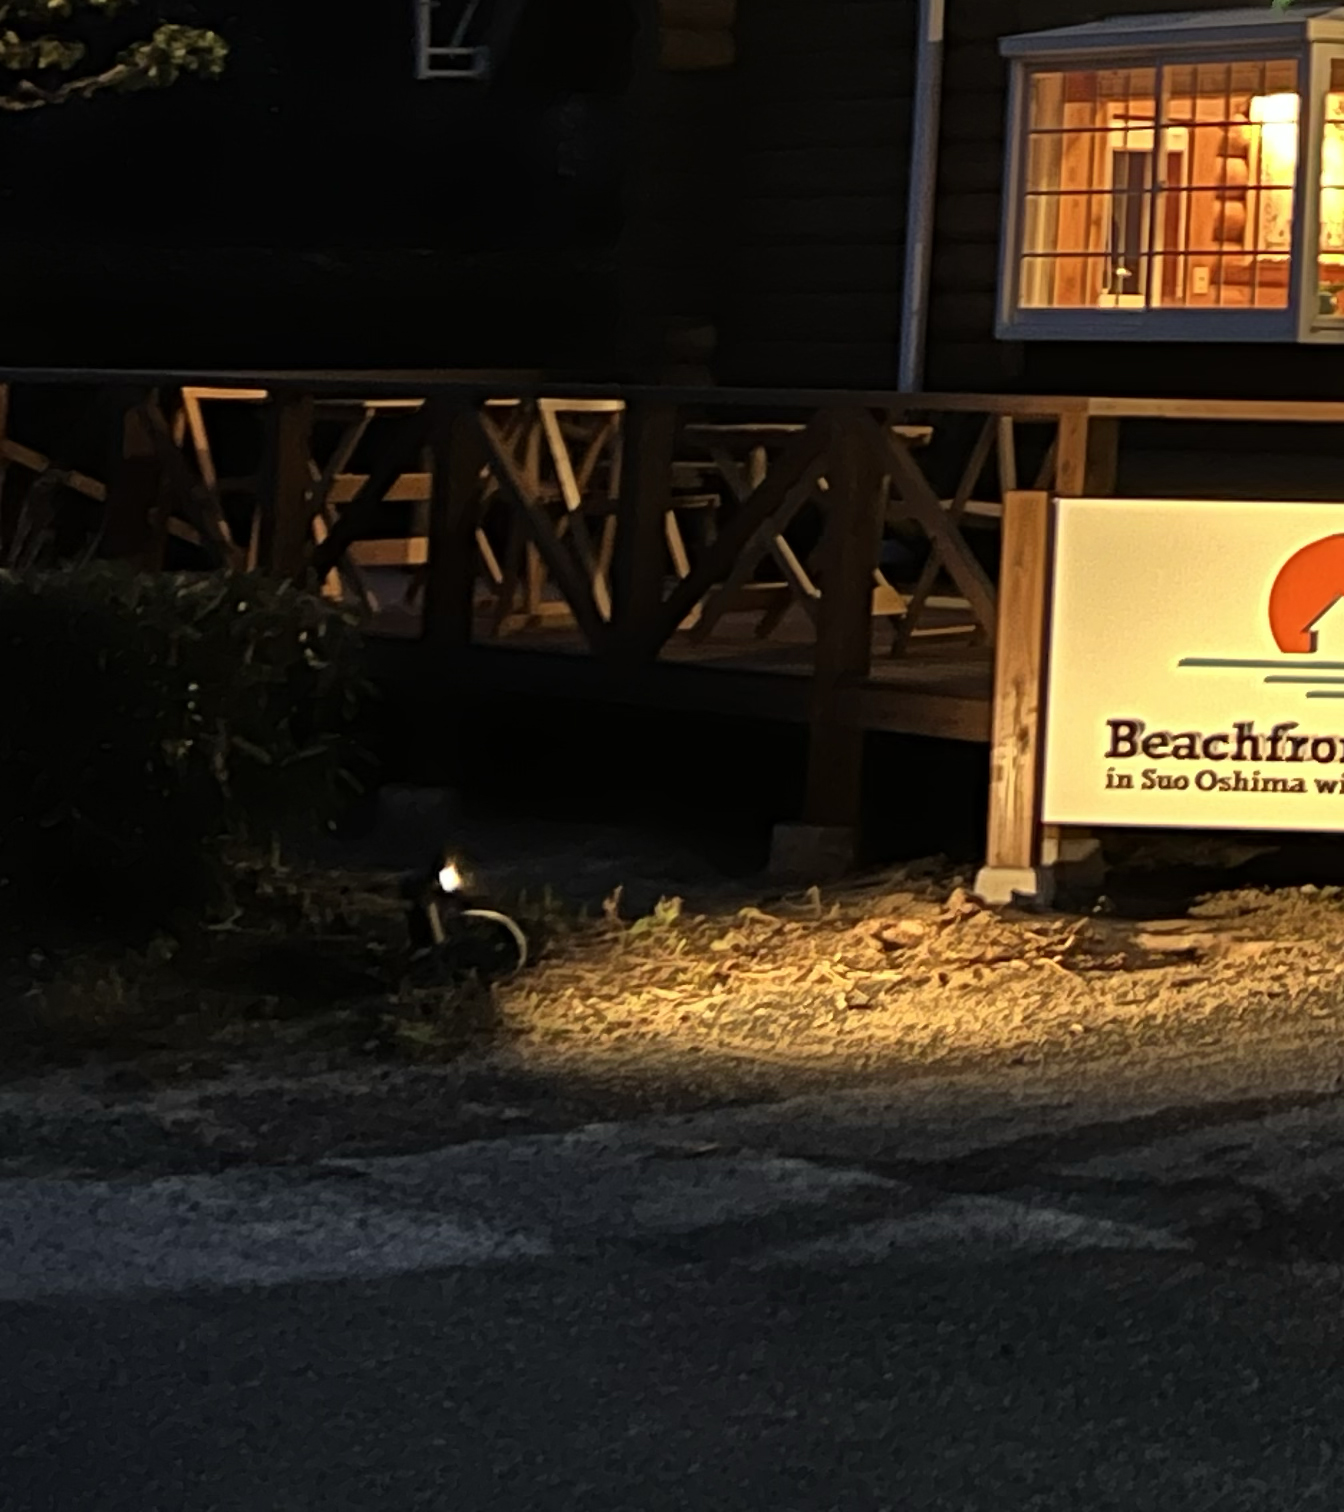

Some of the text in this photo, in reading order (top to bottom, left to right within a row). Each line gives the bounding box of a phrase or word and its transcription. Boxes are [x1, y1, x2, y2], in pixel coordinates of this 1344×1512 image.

[1105, 767, 1134, 790] in
[1140, 768, 1190, 792] Suo
[1194, 769, 1308, 793] Oshima
